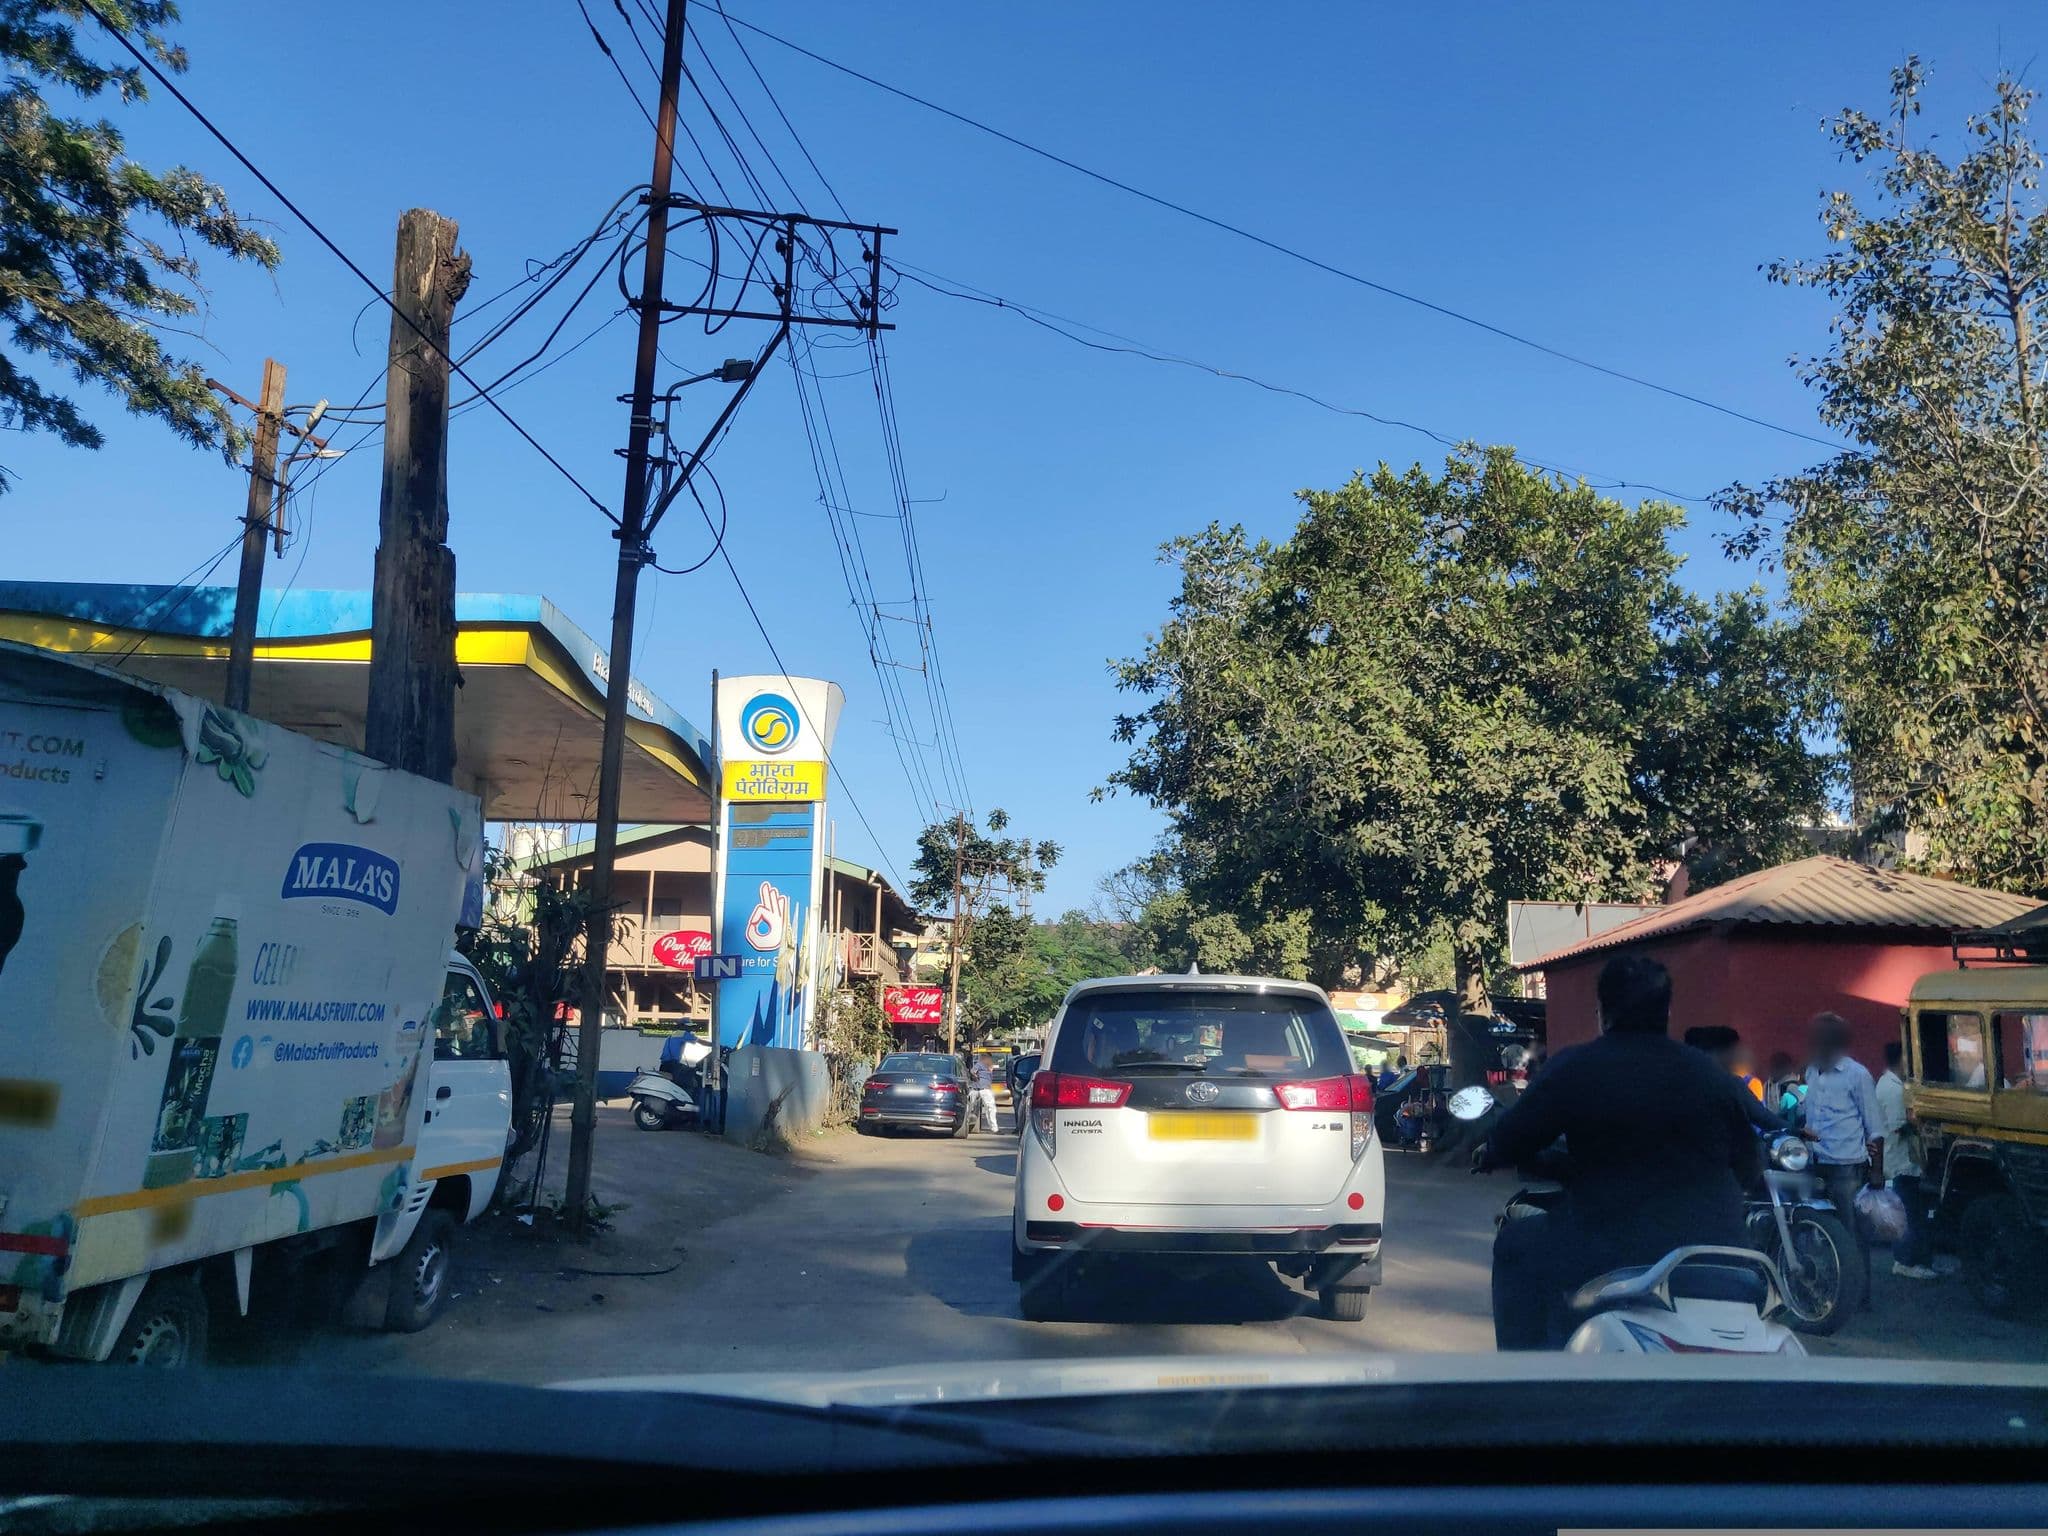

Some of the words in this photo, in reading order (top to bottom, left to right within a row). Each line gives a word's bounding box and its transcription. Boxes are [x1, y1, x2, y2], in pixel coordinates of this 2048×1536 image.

[750, 764, 795, 777] भारत
[292, 856, 394, 902] MALA'S
[661, 936, 686, 952] Pan
[701, 958, 736, 977] IN
[757, 956, 771, 968] for
[912, 991, 940, 1006] Hill
[246, 1000, 386, 1022] WWW.MALASFRUIT.COM
[897, 1006, 928, 1020] Hotel
[273, 1041, 379, 1063] @MalasFruitProducts
[1063, 1120, 1103, 1128] INNOVA
